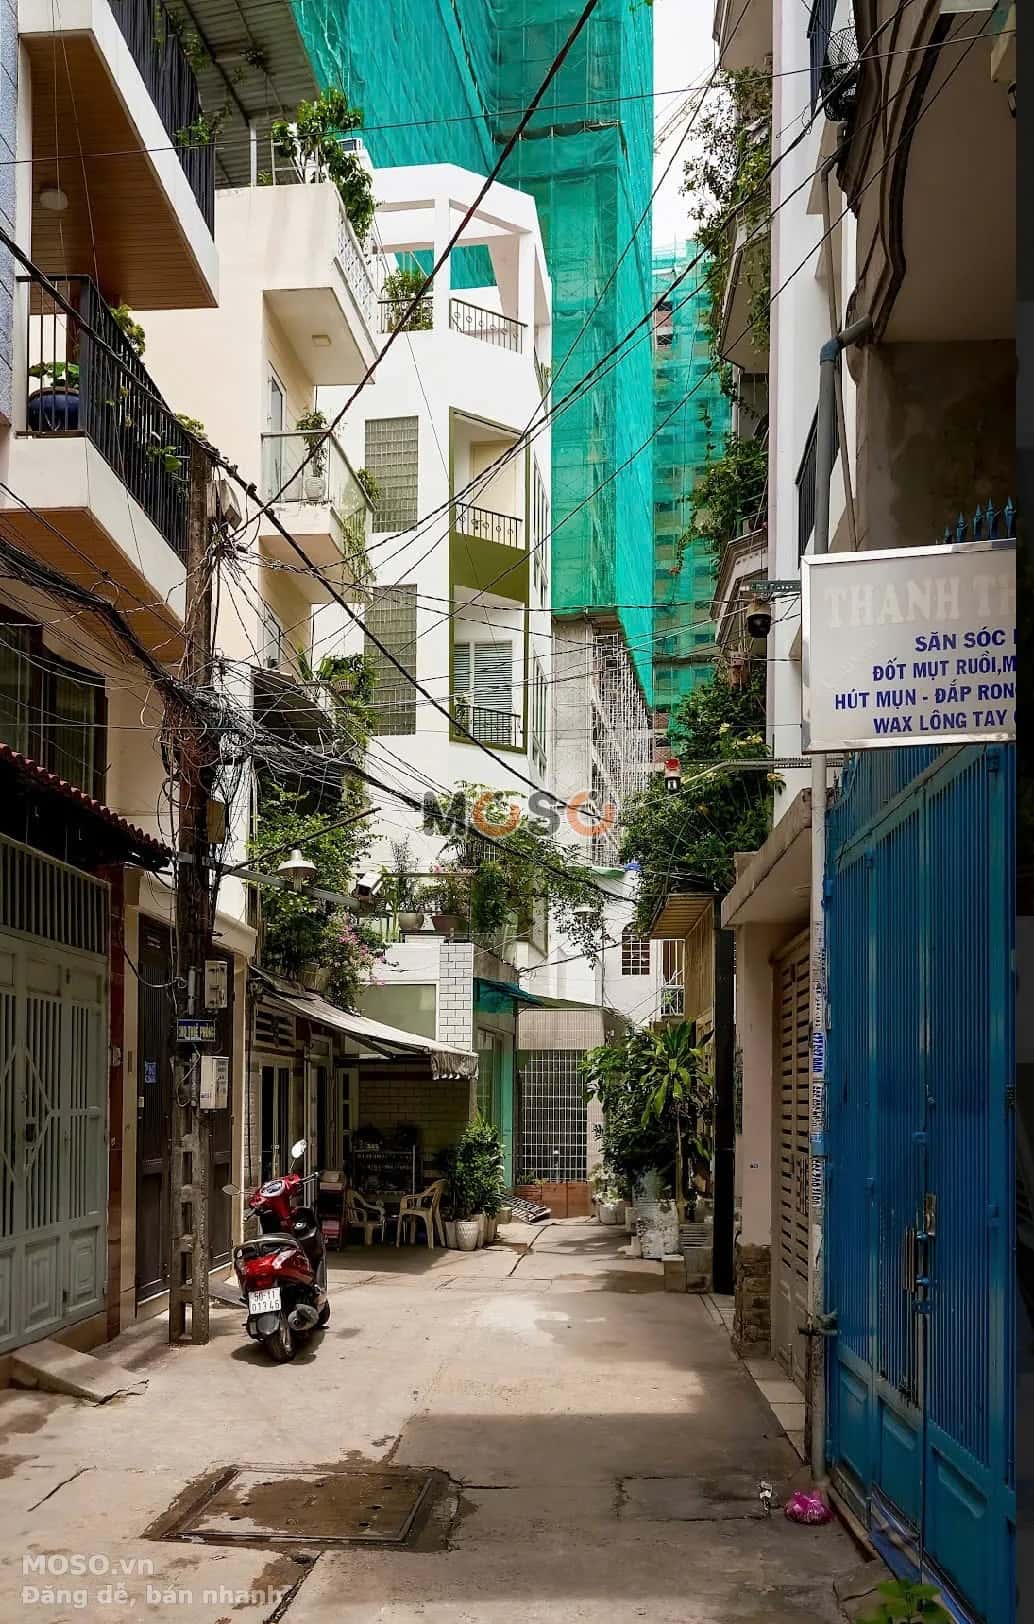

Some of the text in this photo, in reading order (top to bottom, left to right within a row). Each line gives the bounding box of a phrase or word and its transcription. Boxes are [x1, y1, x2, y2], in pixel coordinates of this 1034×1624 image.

[824, 575, 961, 628] THANH
[963, 626, 1006, 648] SÓC
[872, 657, 907, 681] ĐỐT
[912, 660, 949, 680] MỤT
[835, 688, 870, 710] HÚT
[876, 688, 916, 709] MỤN
[934, 679, 972, 703] ĐẮP
[977, 682, 1016, 700] RON
[873, 715, 913, 734] WAX
[919, 709, 967, 731] LÔNG
[972, 709, 1007, 727] TAY
